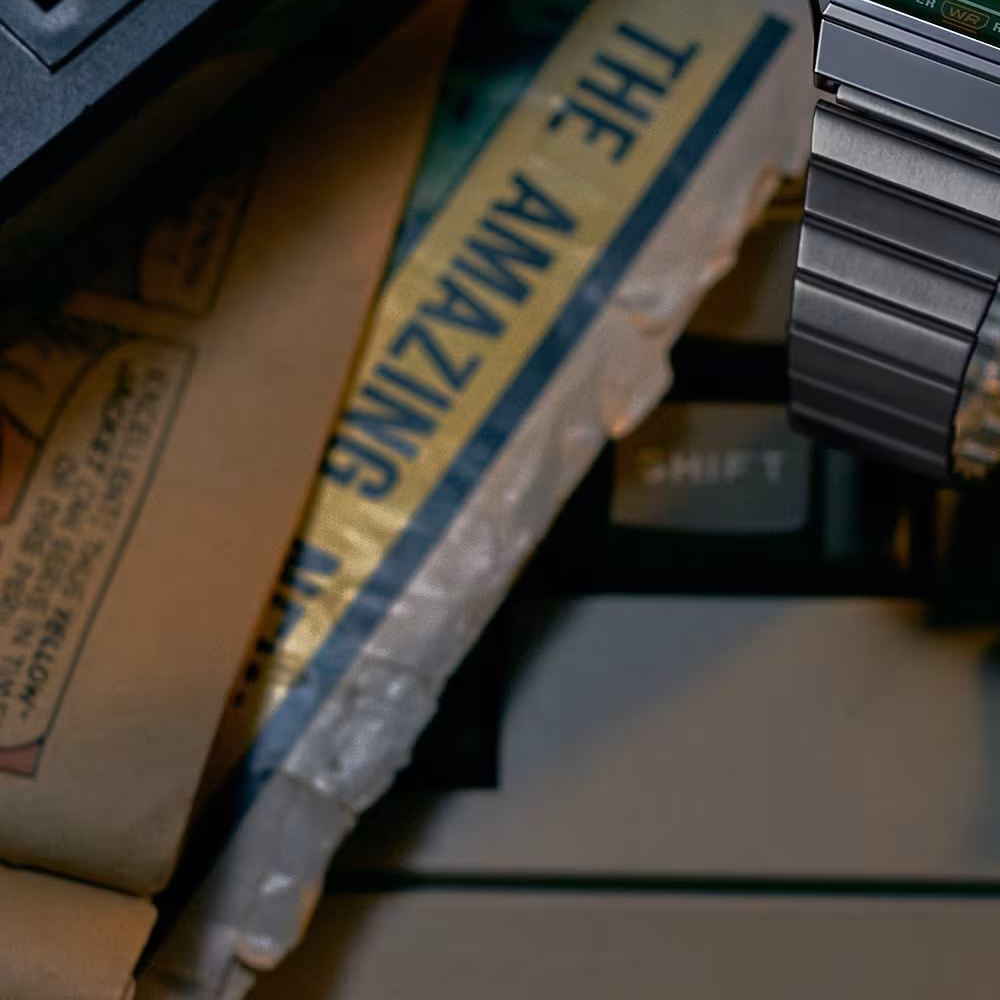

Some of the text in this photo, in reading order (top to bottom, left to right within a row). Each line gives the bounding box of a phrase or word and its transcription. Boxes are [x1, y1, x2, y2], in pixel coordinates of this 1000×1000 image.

[949, 7, 982, 25] WR
[320, 23, 698, 501] THE AMAZING
[638, 449, 789, 484] SHIFT
